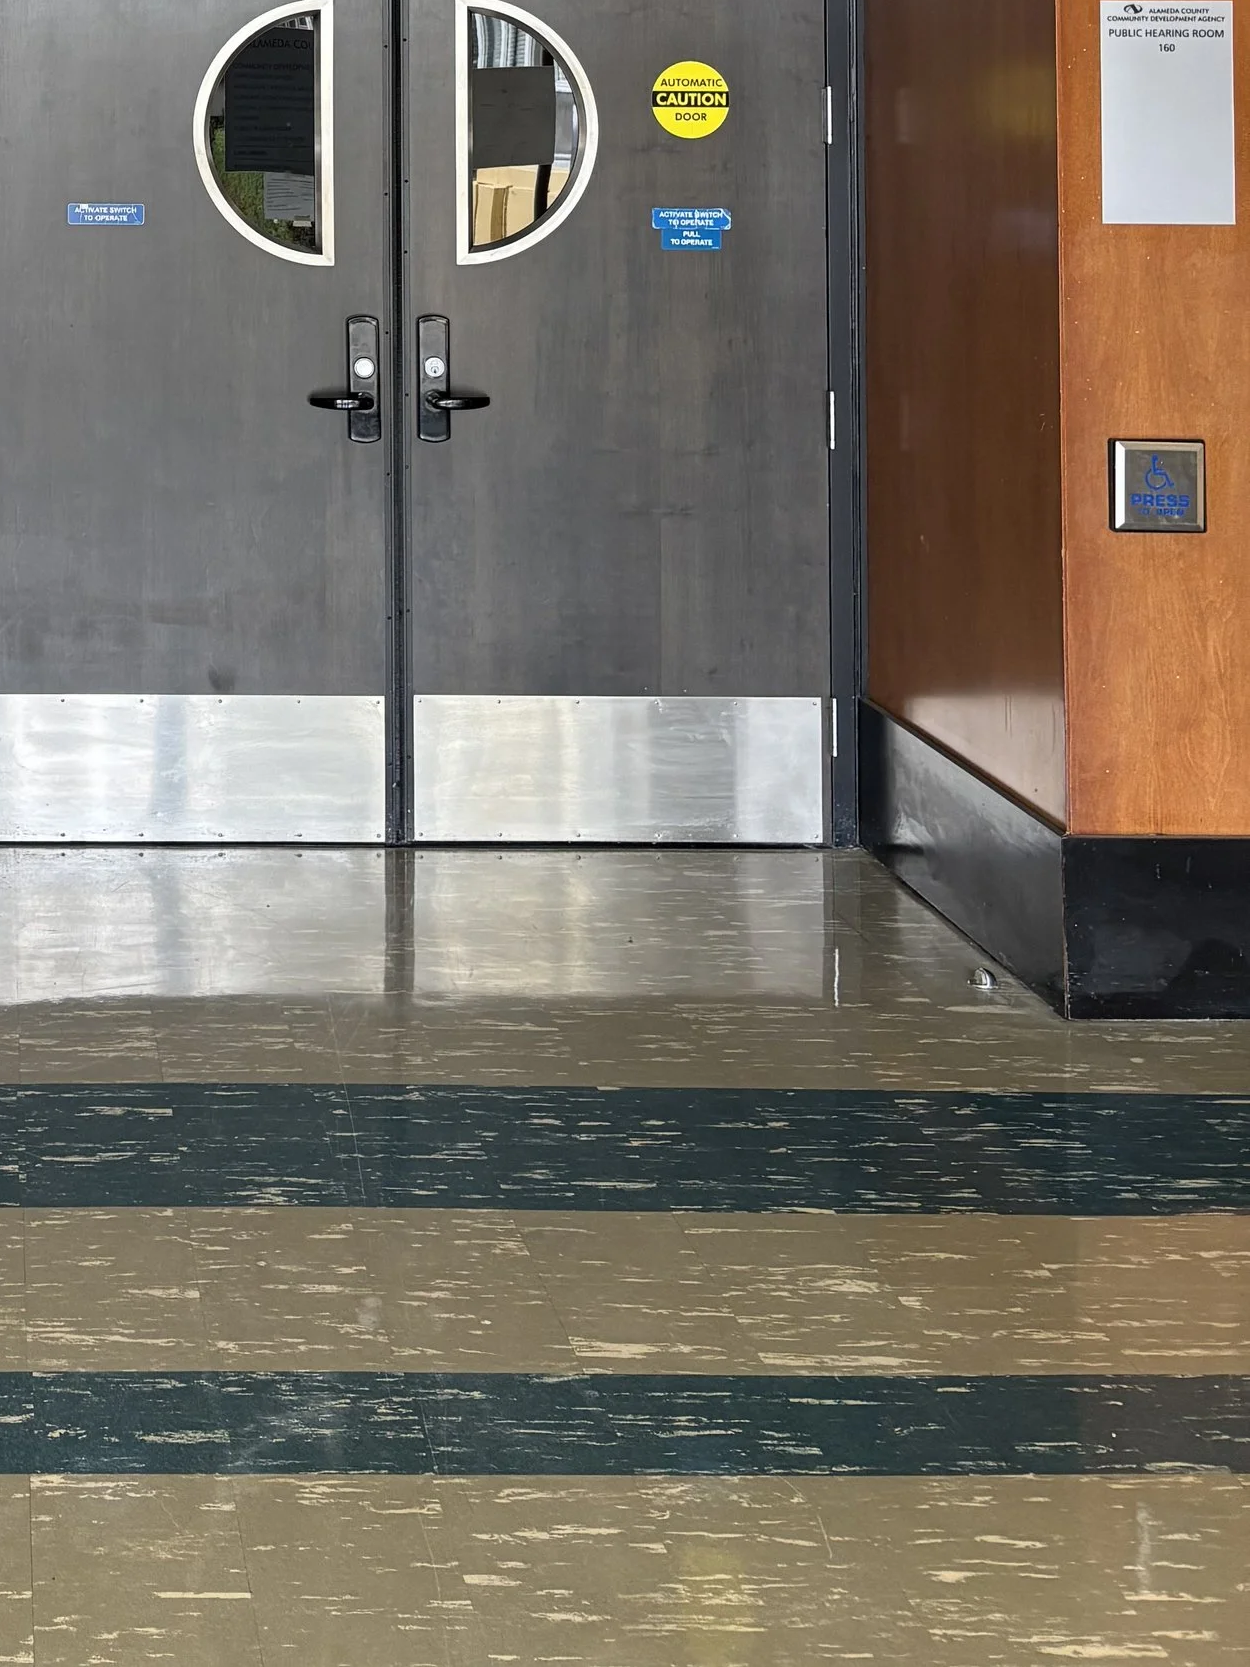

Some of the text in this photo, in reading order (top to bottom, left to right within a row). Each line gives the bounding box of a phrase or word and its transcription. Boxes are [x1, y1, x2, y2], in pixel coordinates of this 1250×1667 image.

[1108, 28, 1225, 38] PUBLIC HEARING ROOM
[251, 38, 291, 48] LAMEDA
[1159, 43, 1176, 52] 160
[660, 78, 723, 87] AUTOMATIC
[656, 92, 727, 106] CAUTION
[675, 112, 708, 121] DOOR
[94, 214, 128, 222] OPERATE
[1131, 493, 1190, 507] PRESS
